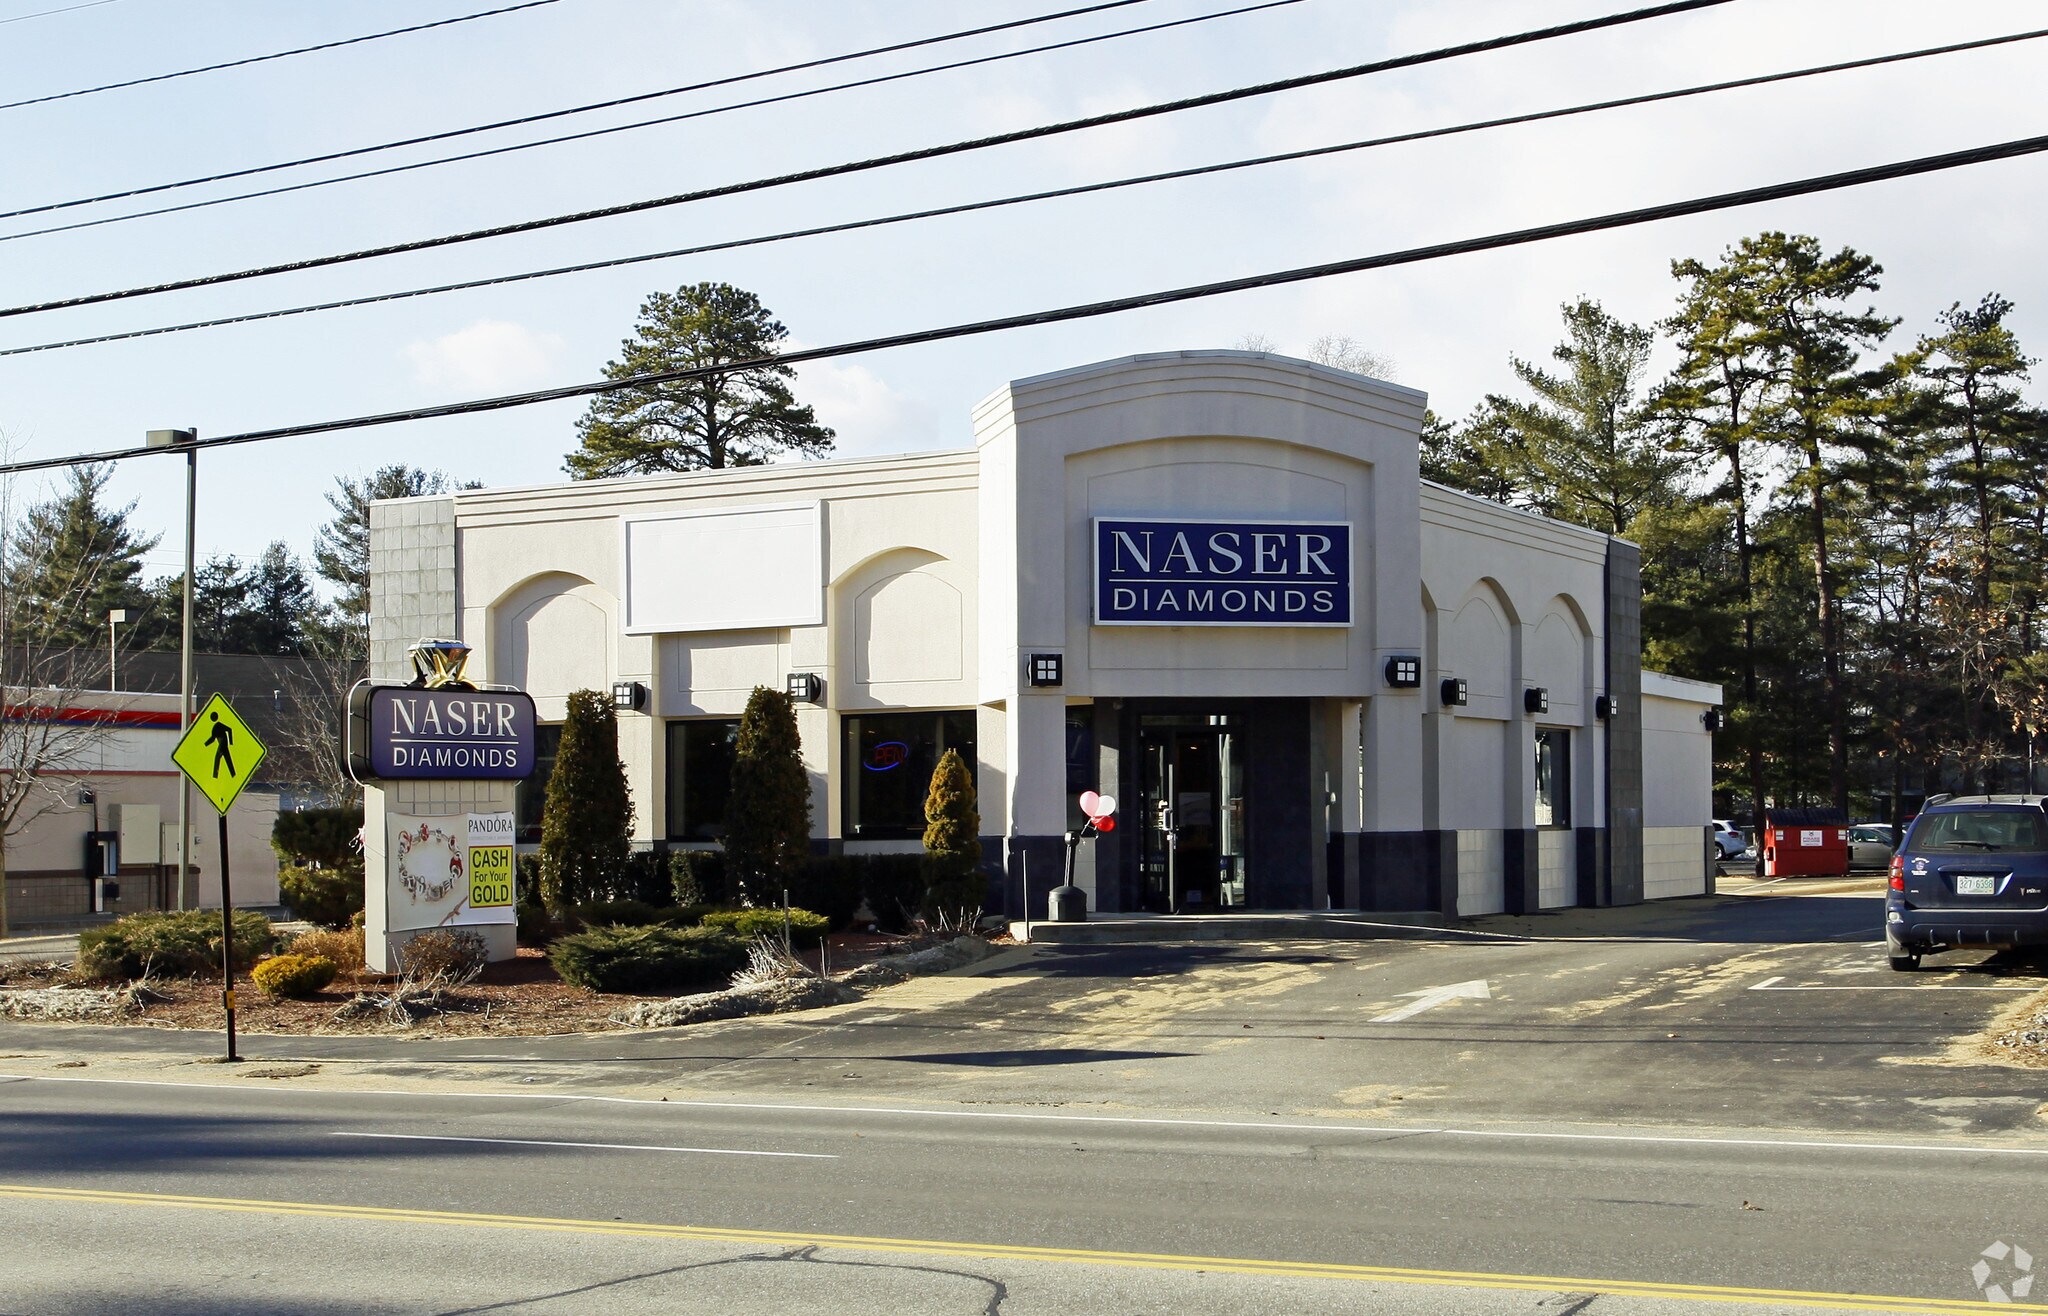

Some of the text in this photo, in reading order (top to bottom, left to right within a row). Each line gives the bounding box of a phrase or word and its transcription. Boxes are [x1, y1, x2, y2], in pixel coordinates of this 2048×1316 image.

[1110, 531, 1335, 575] NASER
[1113, 588, 1334, 613] DIAMONDS
[391, 698, 518, 737] NASER
[393, 747, 517, 768] DIAMONDS
[468, 817, 513, 833] PANDORA
[472, 850, 509, 868] CASH
[474, 870, 507, 883] For Your
[472, 884, 509, 903] GOLD
